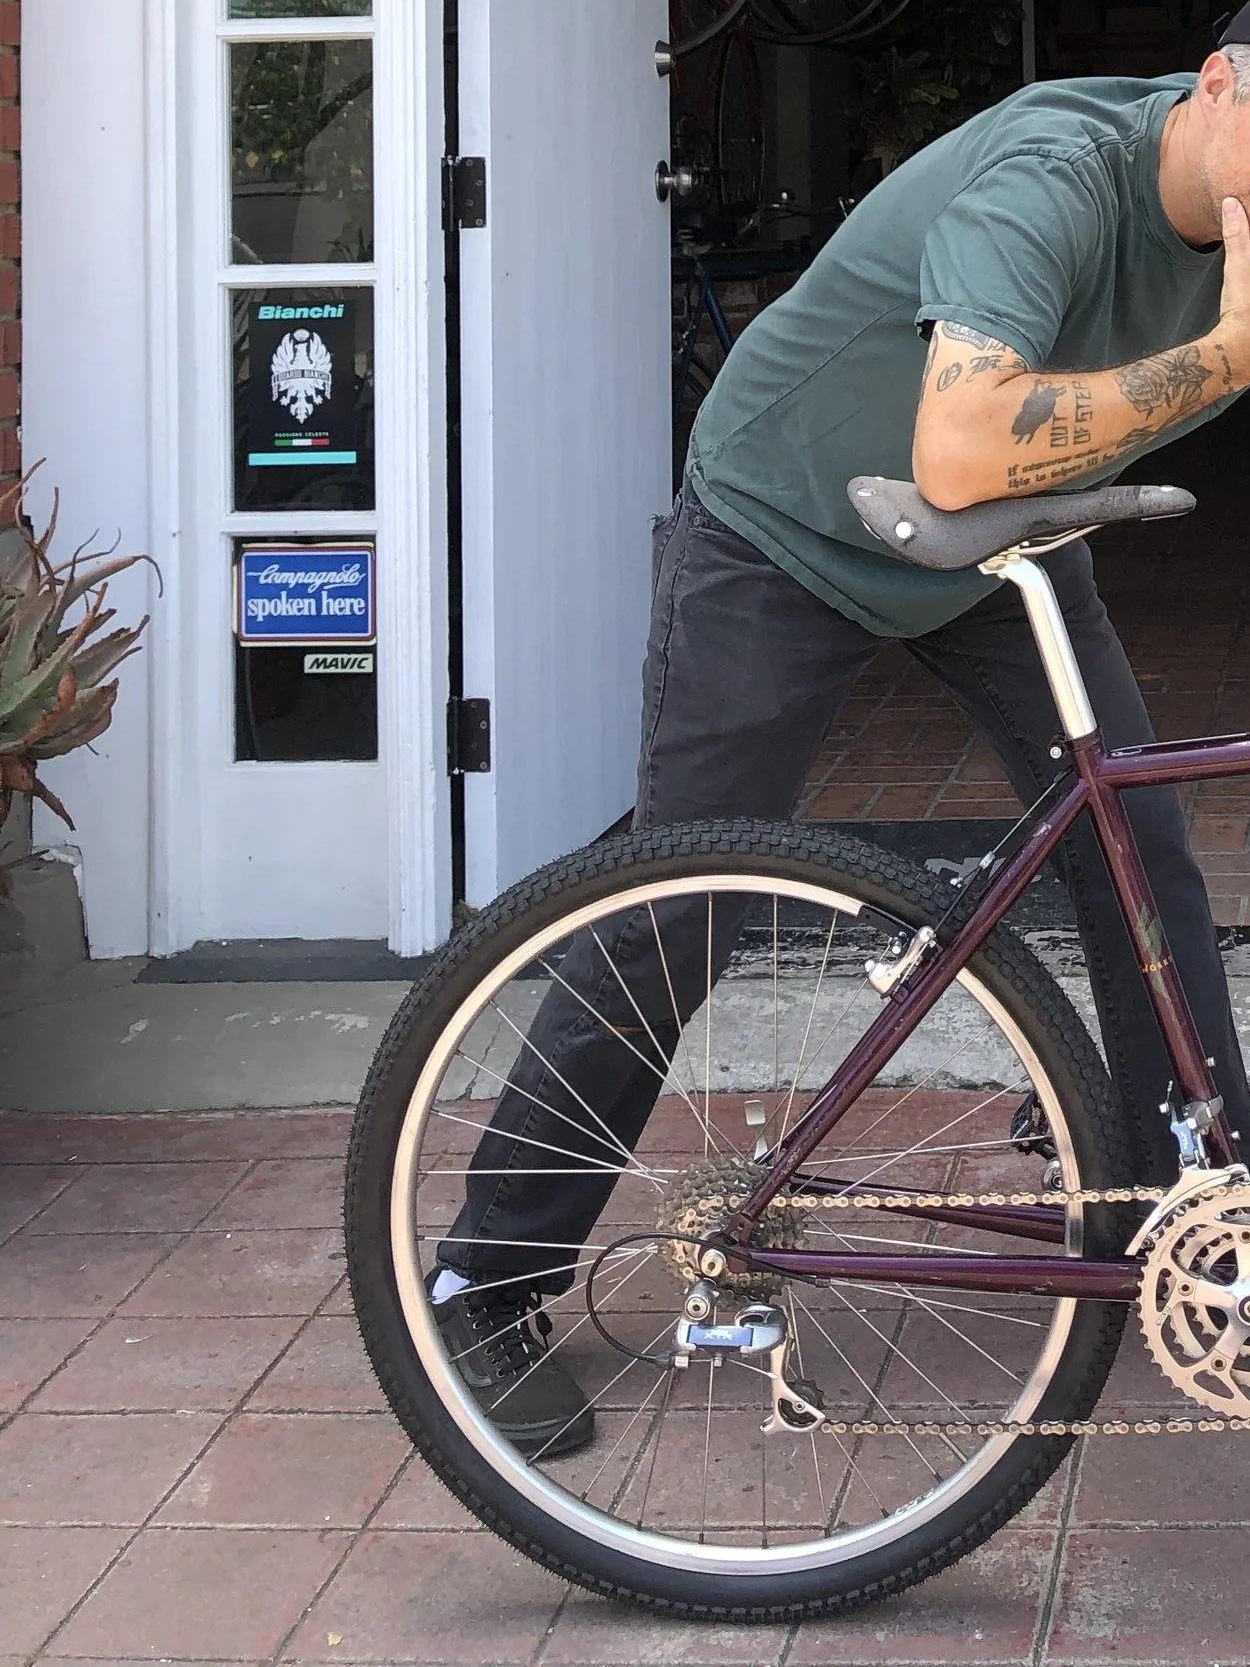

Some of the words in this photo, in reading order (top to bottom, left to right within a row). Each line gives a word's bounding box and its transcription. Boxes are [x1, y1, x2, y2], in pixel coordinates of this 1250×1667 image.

[258, 303, 345, 320] Bianchi
[1049, 412, 1069, 448] OUT
[246, 563, 367, 594] Campagnolo
[247, 590, 317, 622] spoken
[320, 590, 366, 616] here
[308, 657, 369, 670] MAVIC
